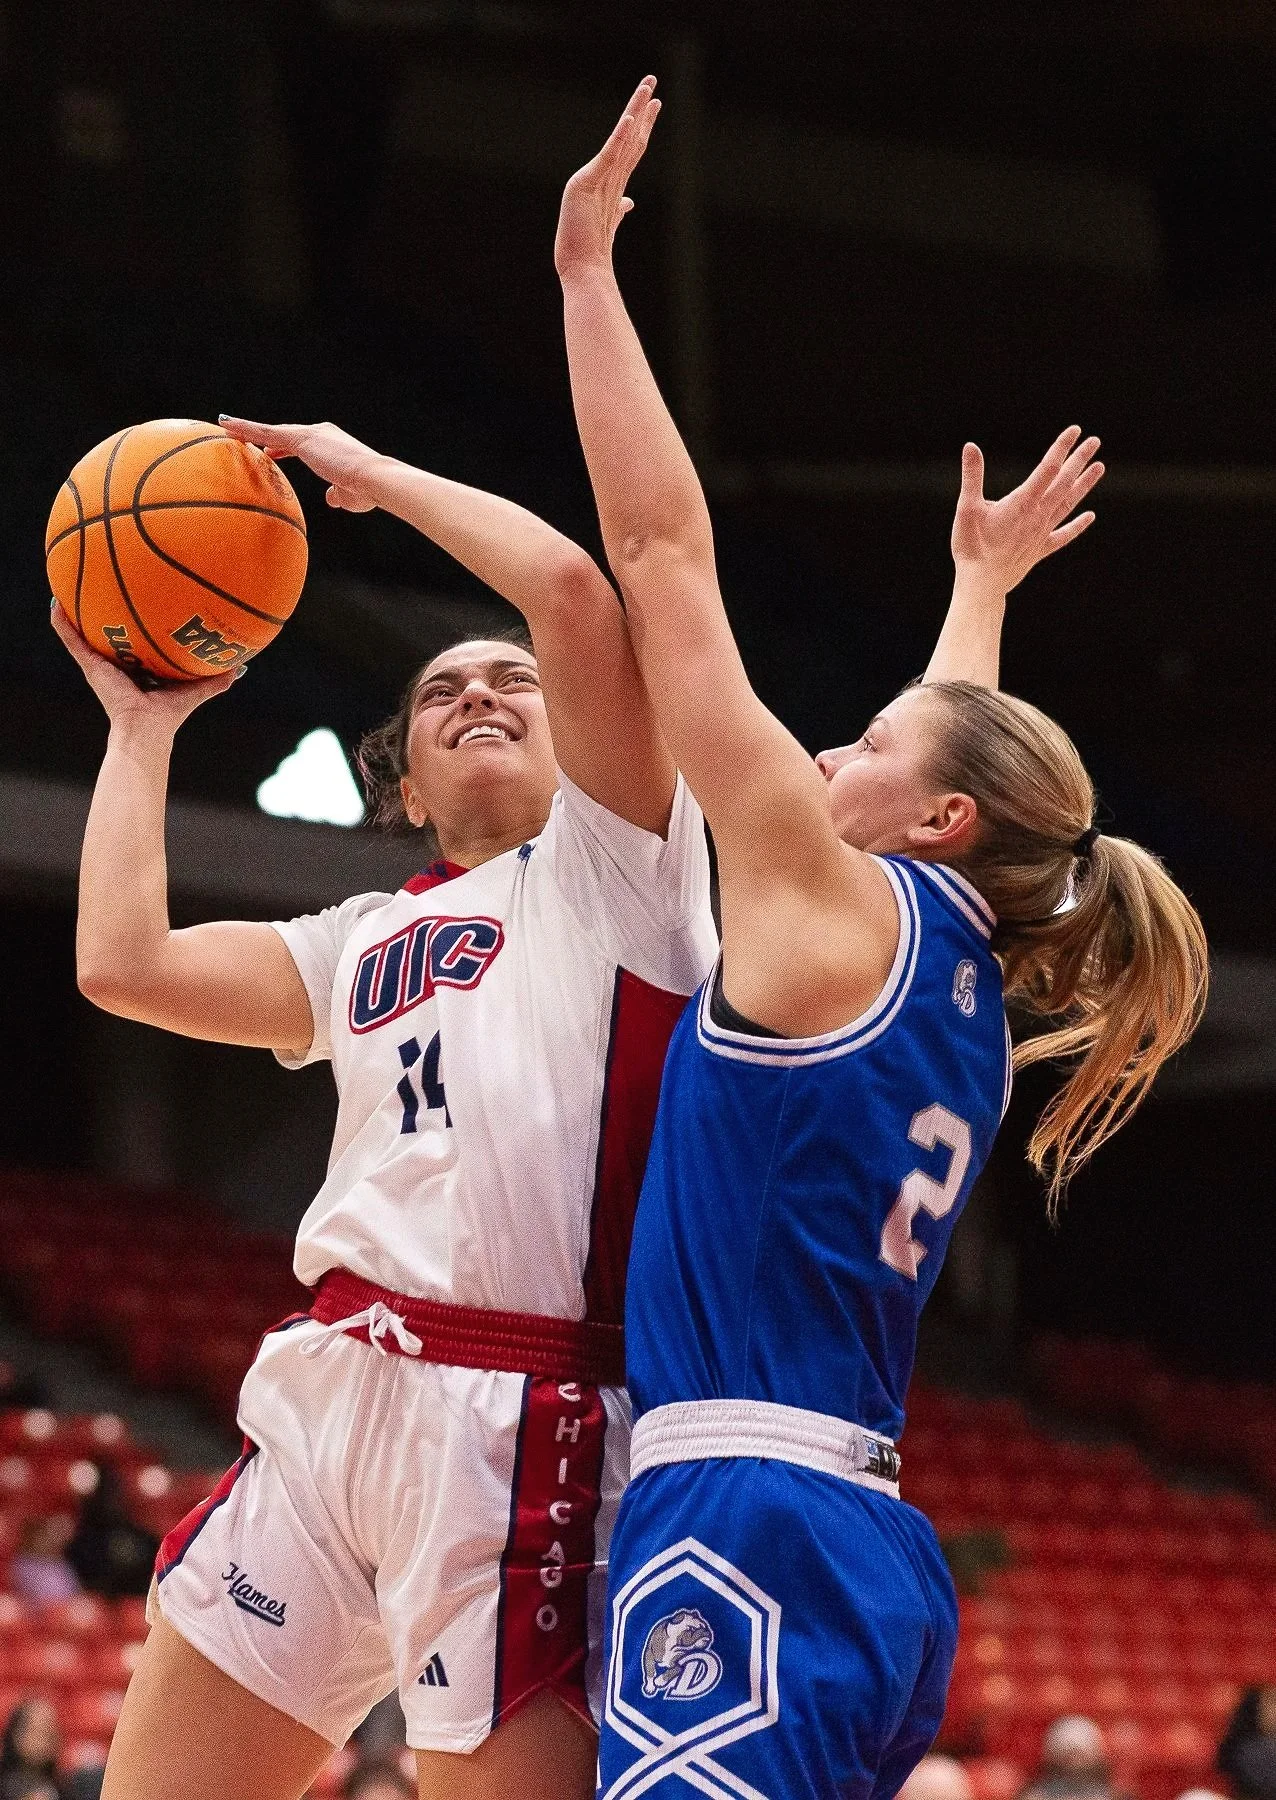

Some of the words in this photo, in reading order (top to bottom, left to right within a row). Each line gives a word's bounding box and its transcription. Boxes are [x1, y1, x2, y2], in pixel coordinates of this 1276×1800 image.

[350, 916, 504, 1034] UIC
[879, 1102, 972, 1281] 2
[536, 1382, 581, 1632] CHICAGO
[221, 1561, 287, 1627] Flames
